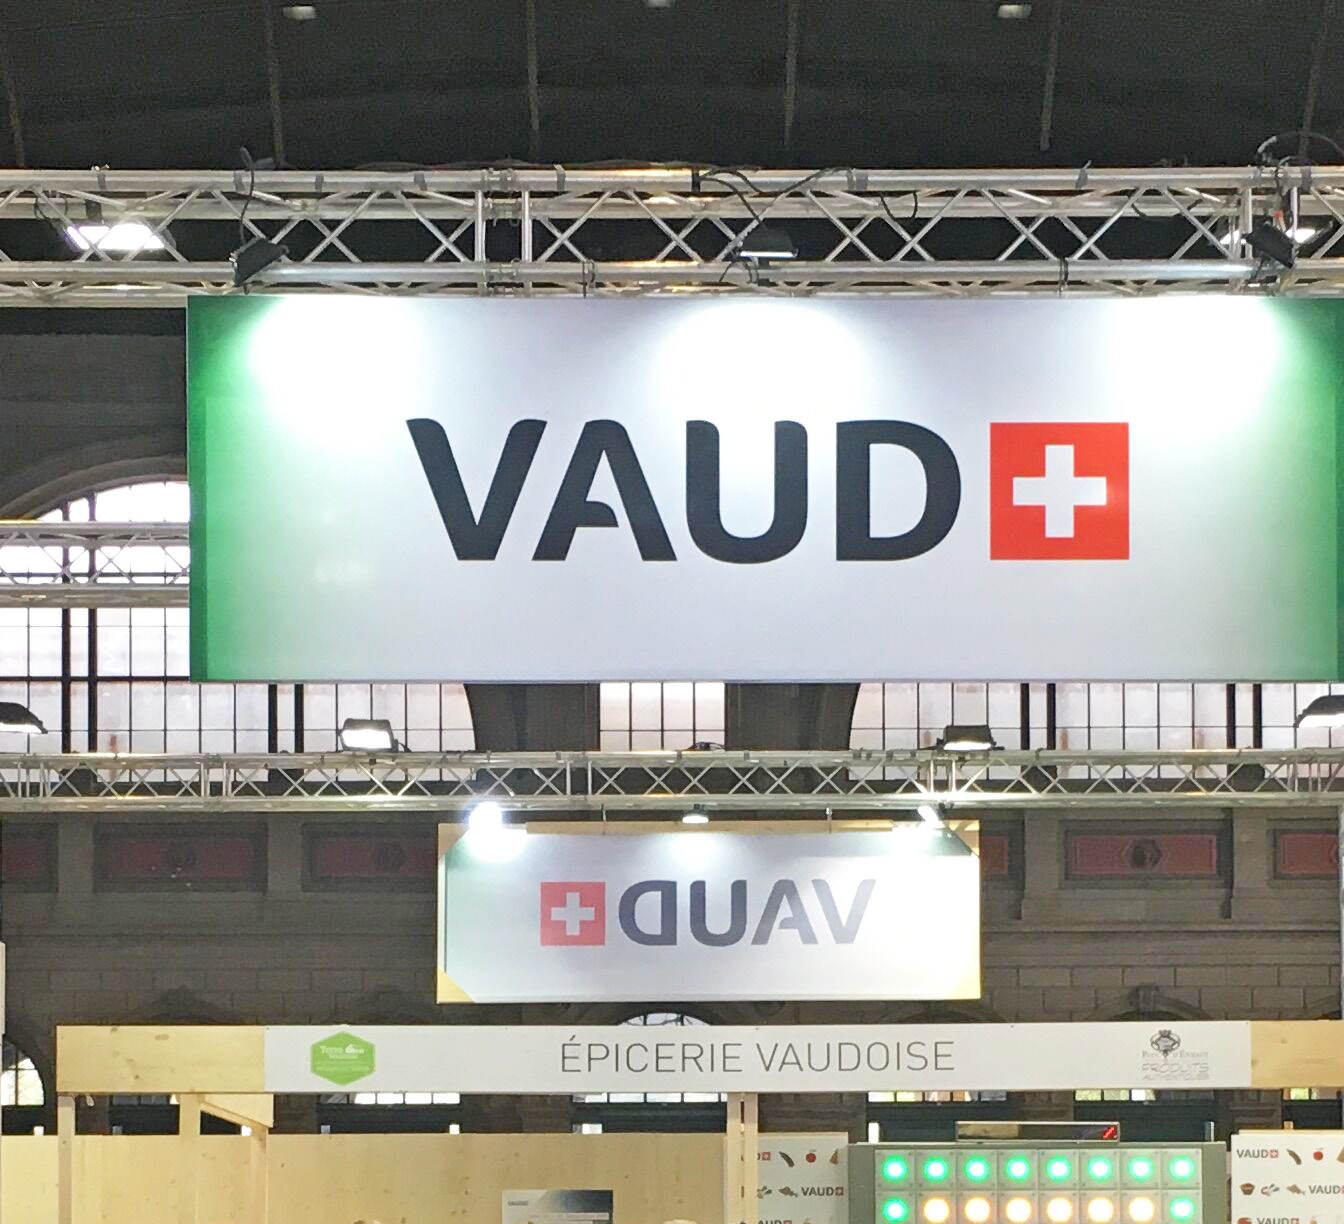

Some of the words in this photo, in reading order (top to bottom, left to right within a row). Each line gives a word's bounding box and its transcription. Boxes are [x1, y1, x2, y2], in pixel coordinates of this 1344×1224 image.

[406, 418, 962, 564] VAUD
[560, 1035, 743, 1074] ÉPICERIE
[755, 1040, 956, 1073] VAUDOISE
[1236, 1149, 1269, 1158] VAUD
[801, 1186, 834, 1196] VAUD
[1308, 1185, 1341, 1194] VAUD
